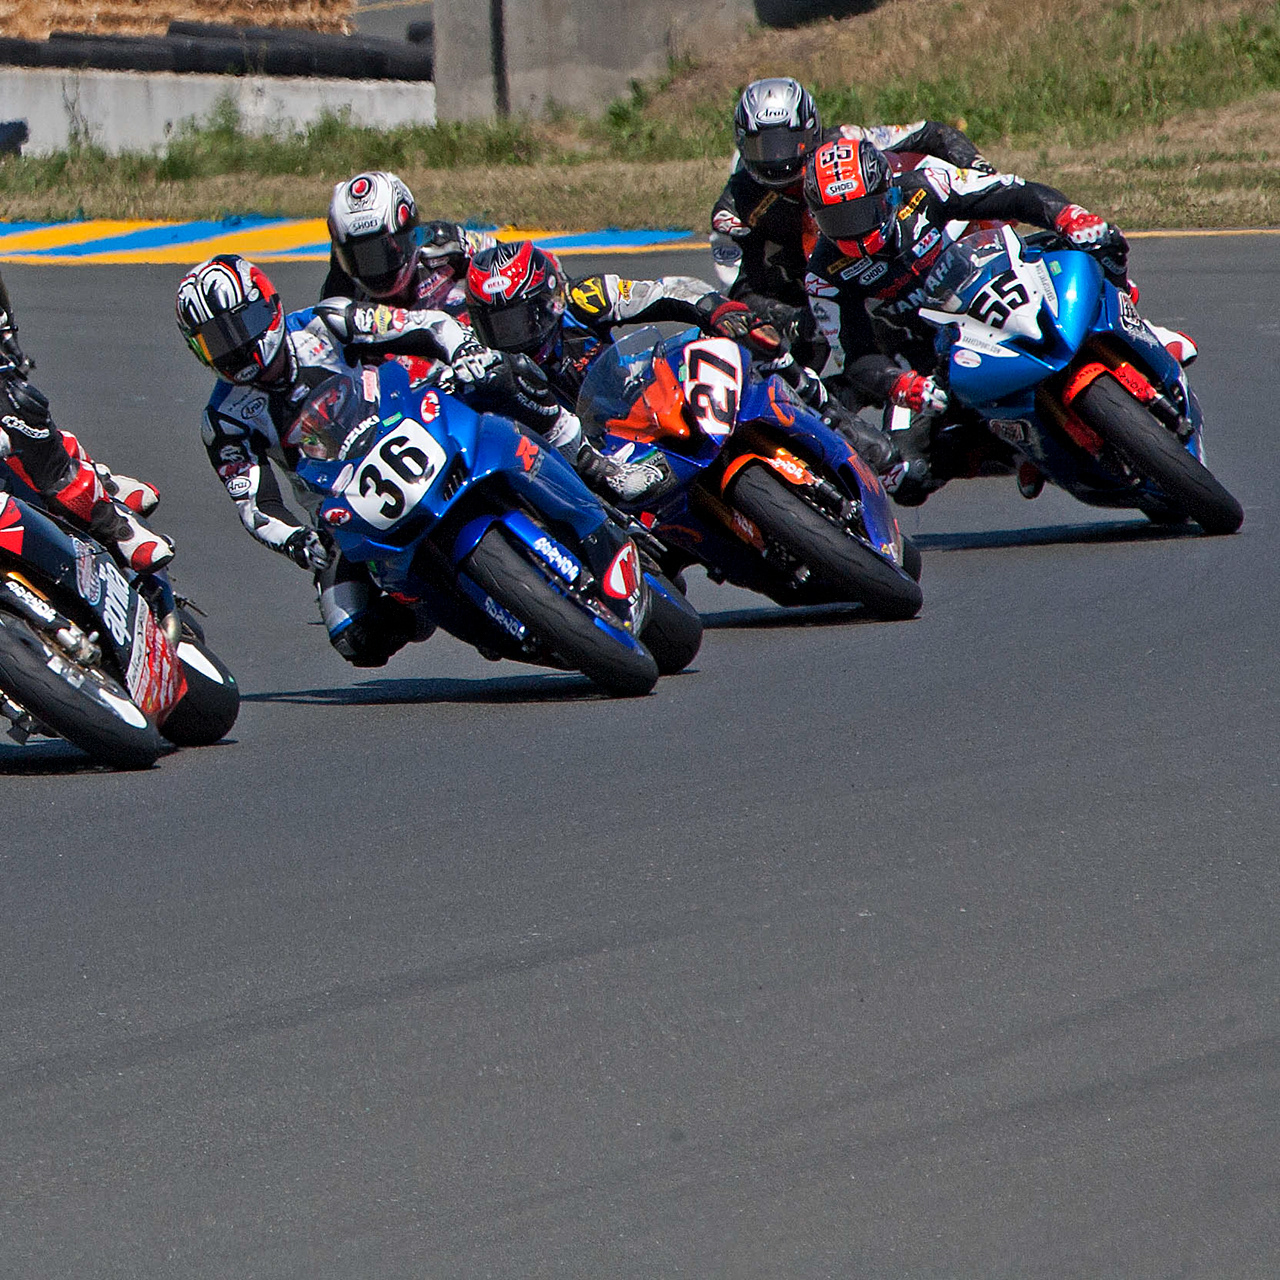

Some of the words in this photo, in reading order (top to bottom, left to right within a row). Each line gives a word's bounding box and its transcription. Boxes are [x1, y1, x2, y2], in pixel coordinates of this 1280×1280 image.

[757, 107, 789, 120] Arai
[829, 181, 854, 195] SHOEI
[351, 219, 379, 233] SHOEI
[486, 279, 507, 290] BELL
[967, 269, 1030, 330] 55
[688, 347, 739, 428] 27
[244, 398, 265, 418] Arai
[338, 414, 381, 462] SUZUKI
[228, 477, 249, 492] Arai
[358, 435, 436, 520] 36
[99, 561, 133, 647] aprilia
